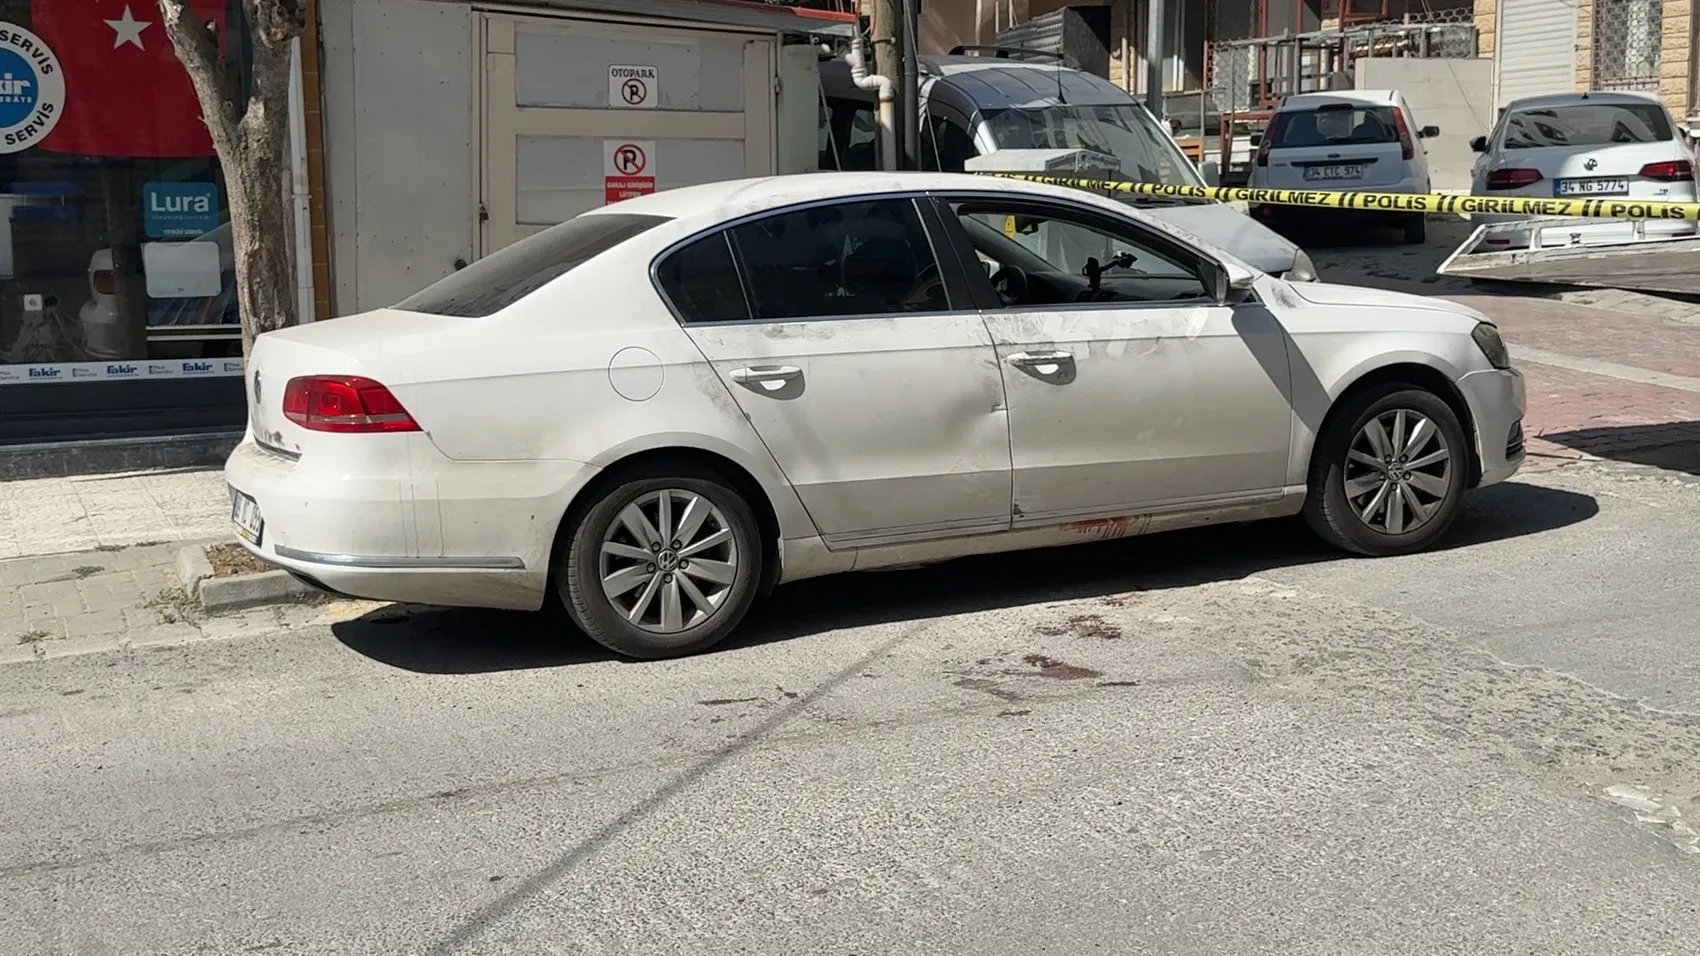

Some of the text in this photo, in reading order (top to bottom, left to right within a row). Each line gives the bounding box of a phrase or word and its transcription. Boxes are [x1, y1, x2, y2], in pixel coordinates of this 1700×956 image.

[611, 68, 656, 79] OTOPARK
[1309, 166, 1361, 177] 34 CTC 974
[1561, 178, 1625, 193] 34 NG 5774
[150, 191, 211, 213] Lura
[29, 367, 61, 377] Fakir
[107, 364, 138, 374] Fakir
[183, 362, 213, 372] Fakir
